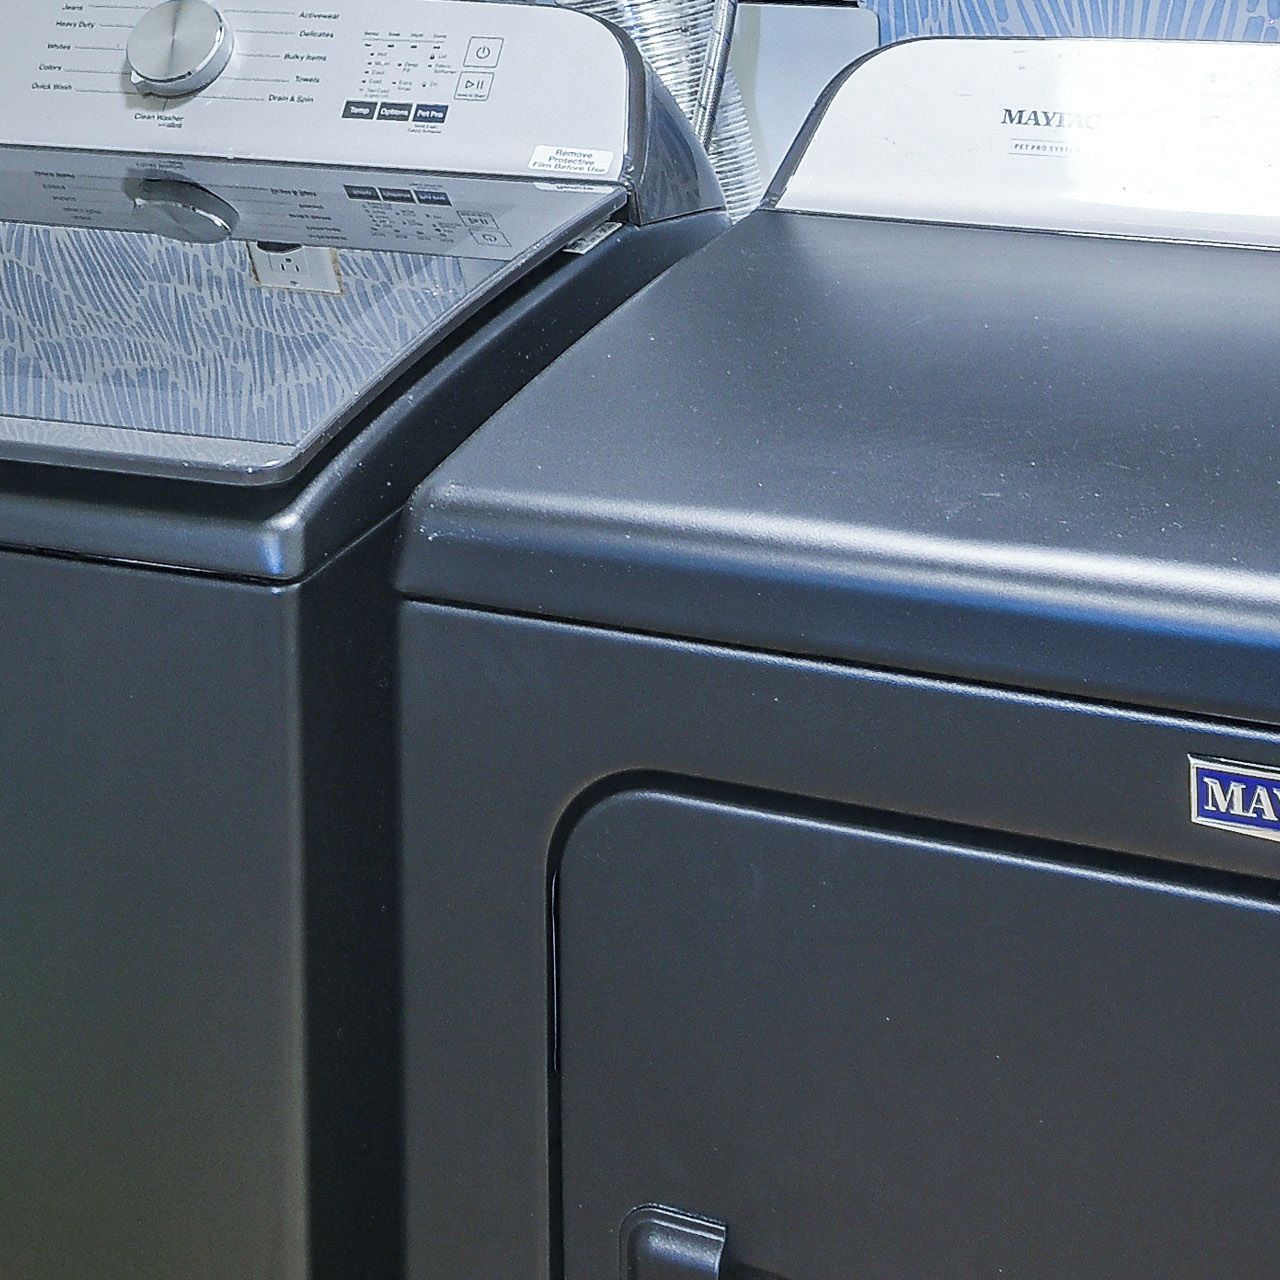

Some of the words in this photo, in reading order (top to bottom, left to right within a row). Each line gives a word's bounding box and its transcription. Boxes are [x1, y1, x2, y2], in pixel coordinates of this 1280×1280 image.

[350, 105, 370, 115] Temp
[380, 108, 409, 117] Options
[555, 149, 594, 159] Remove
[548, 156, 595, 166] Protective
[554, 162, 584, 171] Before
[586, 164, 606, 173] Use
